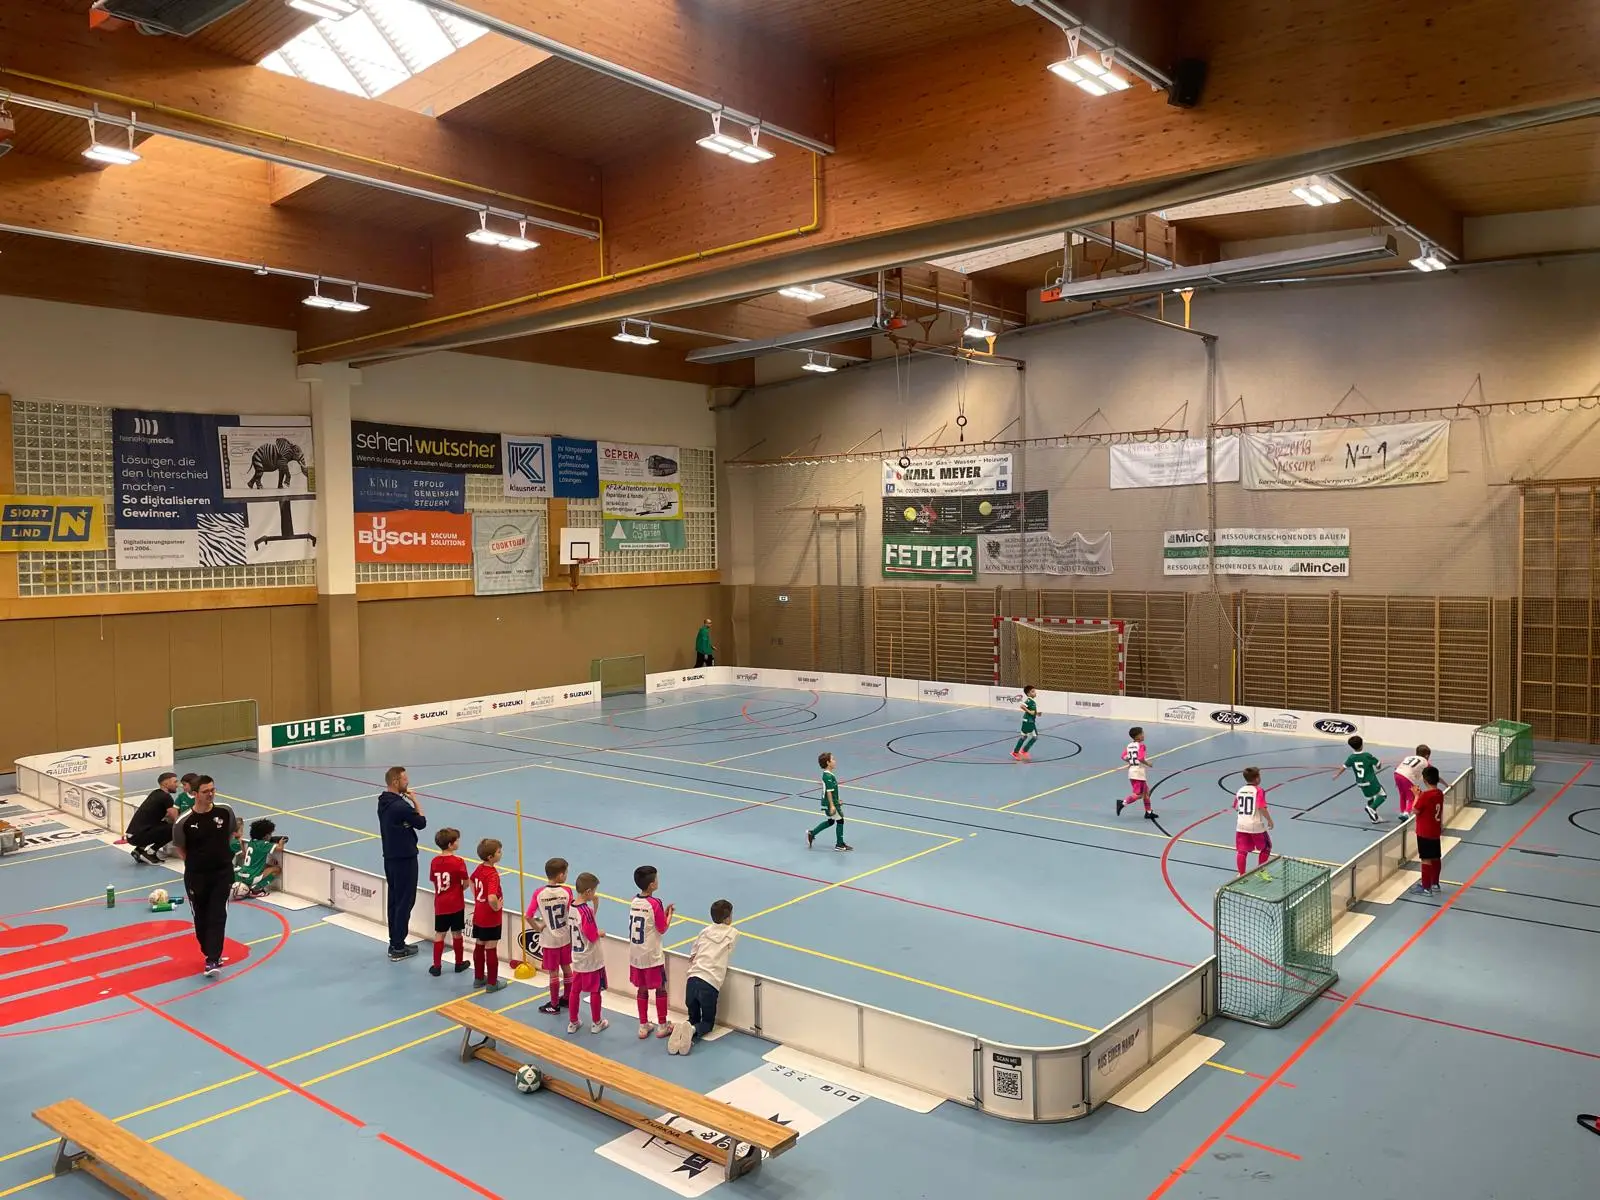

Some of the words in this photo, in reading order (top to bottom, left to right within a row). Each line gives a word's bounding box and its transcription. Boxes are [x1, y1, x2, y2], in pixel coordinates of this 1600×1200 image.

[356, 431, 413, 454] sehen!
[415, 438, 495, 458] wutscher
[604, 448, 640, 460] CEPERA
[121, 454, 176, 469] Lösungen,
[177, 457, 196, 467] die
[121, 468, 144, 478] den
[146, 468, 209, 480] Unterschied
[905, 468, 936, 480] KARL
[940, 466, 981, 480] MEYER
[122, 482, 167, 492] machen
[413, 480, 444, 488] ERFOLG
[509, 483, 546, 493] klausner.at
[122, 494, 138, 504] So
[140, 495, 211, 507] digitalisieren
[414, 499, 450, 507] STEUERN
[9, 508, 49, 518] SORT
[122, 508, 180, 518] Gewinner.
[11, 528, 41, 538] LND
[1175, 531, 1217, 543] MinCel
[1319, 532, 1346, 540] BAUEN
[885, 542, 974, 567] FETTER
[1258, 563, 1283, 571] BAUEN
[569, 689, 592, 698] SUZUKI
[498, 700, 523, 709] SUZUKI
[420, 710, 448, 719] SUZUKI
[286, 718, 346, 740] UHER
[1321, 720, 1351, 734] Ford
[115, 750, 156, 763] SUZUKI
[1354, 761, 1365, 778] 5
[1238, 796, 1254, 815] 20
[244, 846, 254, 867] 6
[434, 871, 451, 895] 13
[545, 903, 566, 930] 12
[996, 1054, 1010, 1063] SCAN
